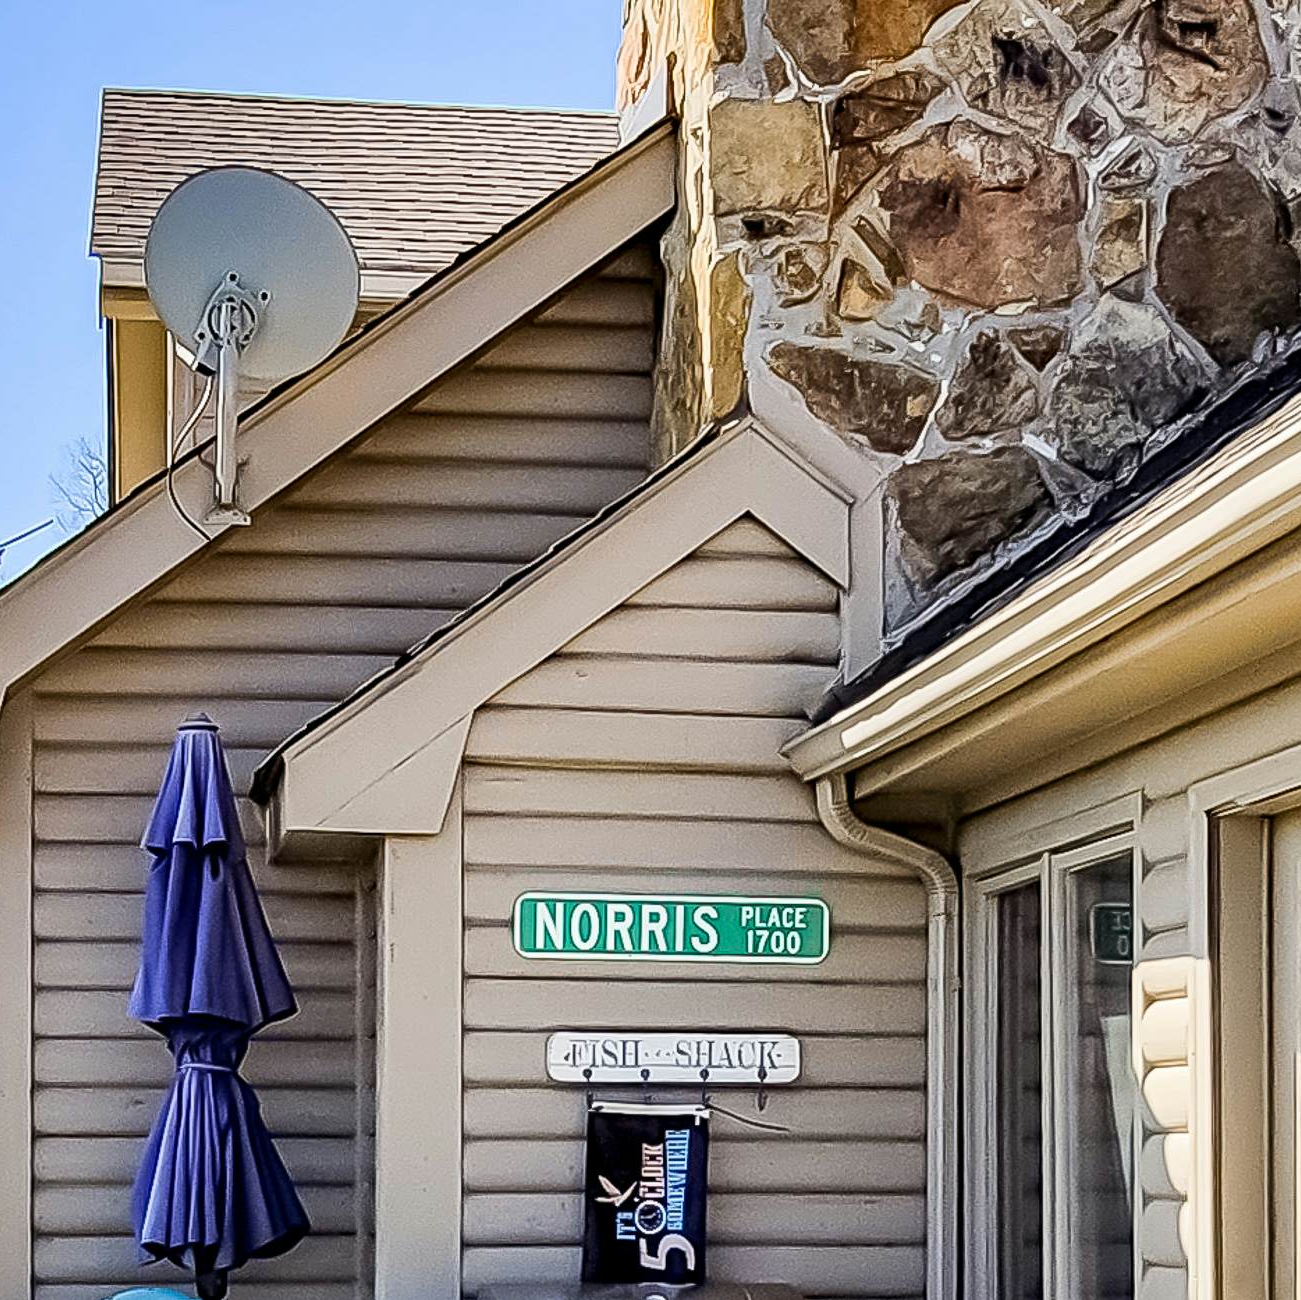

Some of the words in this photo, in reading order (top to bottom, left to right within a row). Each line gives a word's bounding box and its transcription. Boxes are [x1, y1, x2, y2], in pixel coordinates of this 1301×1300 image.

[534, 901, 720, 953] NORRIS
[740, 906, 807, 929] PLACE
[746, 930, 802, 955] 1700
[569, 1039, 642, 1068] FISH
[674, 1039, 779, 1070] SHACK
[665, 1128, 691, 1231] SOMEWHERE
[616, 1211, 636, 1241] IT'S
[639, 1233, 695, 1271] 5
